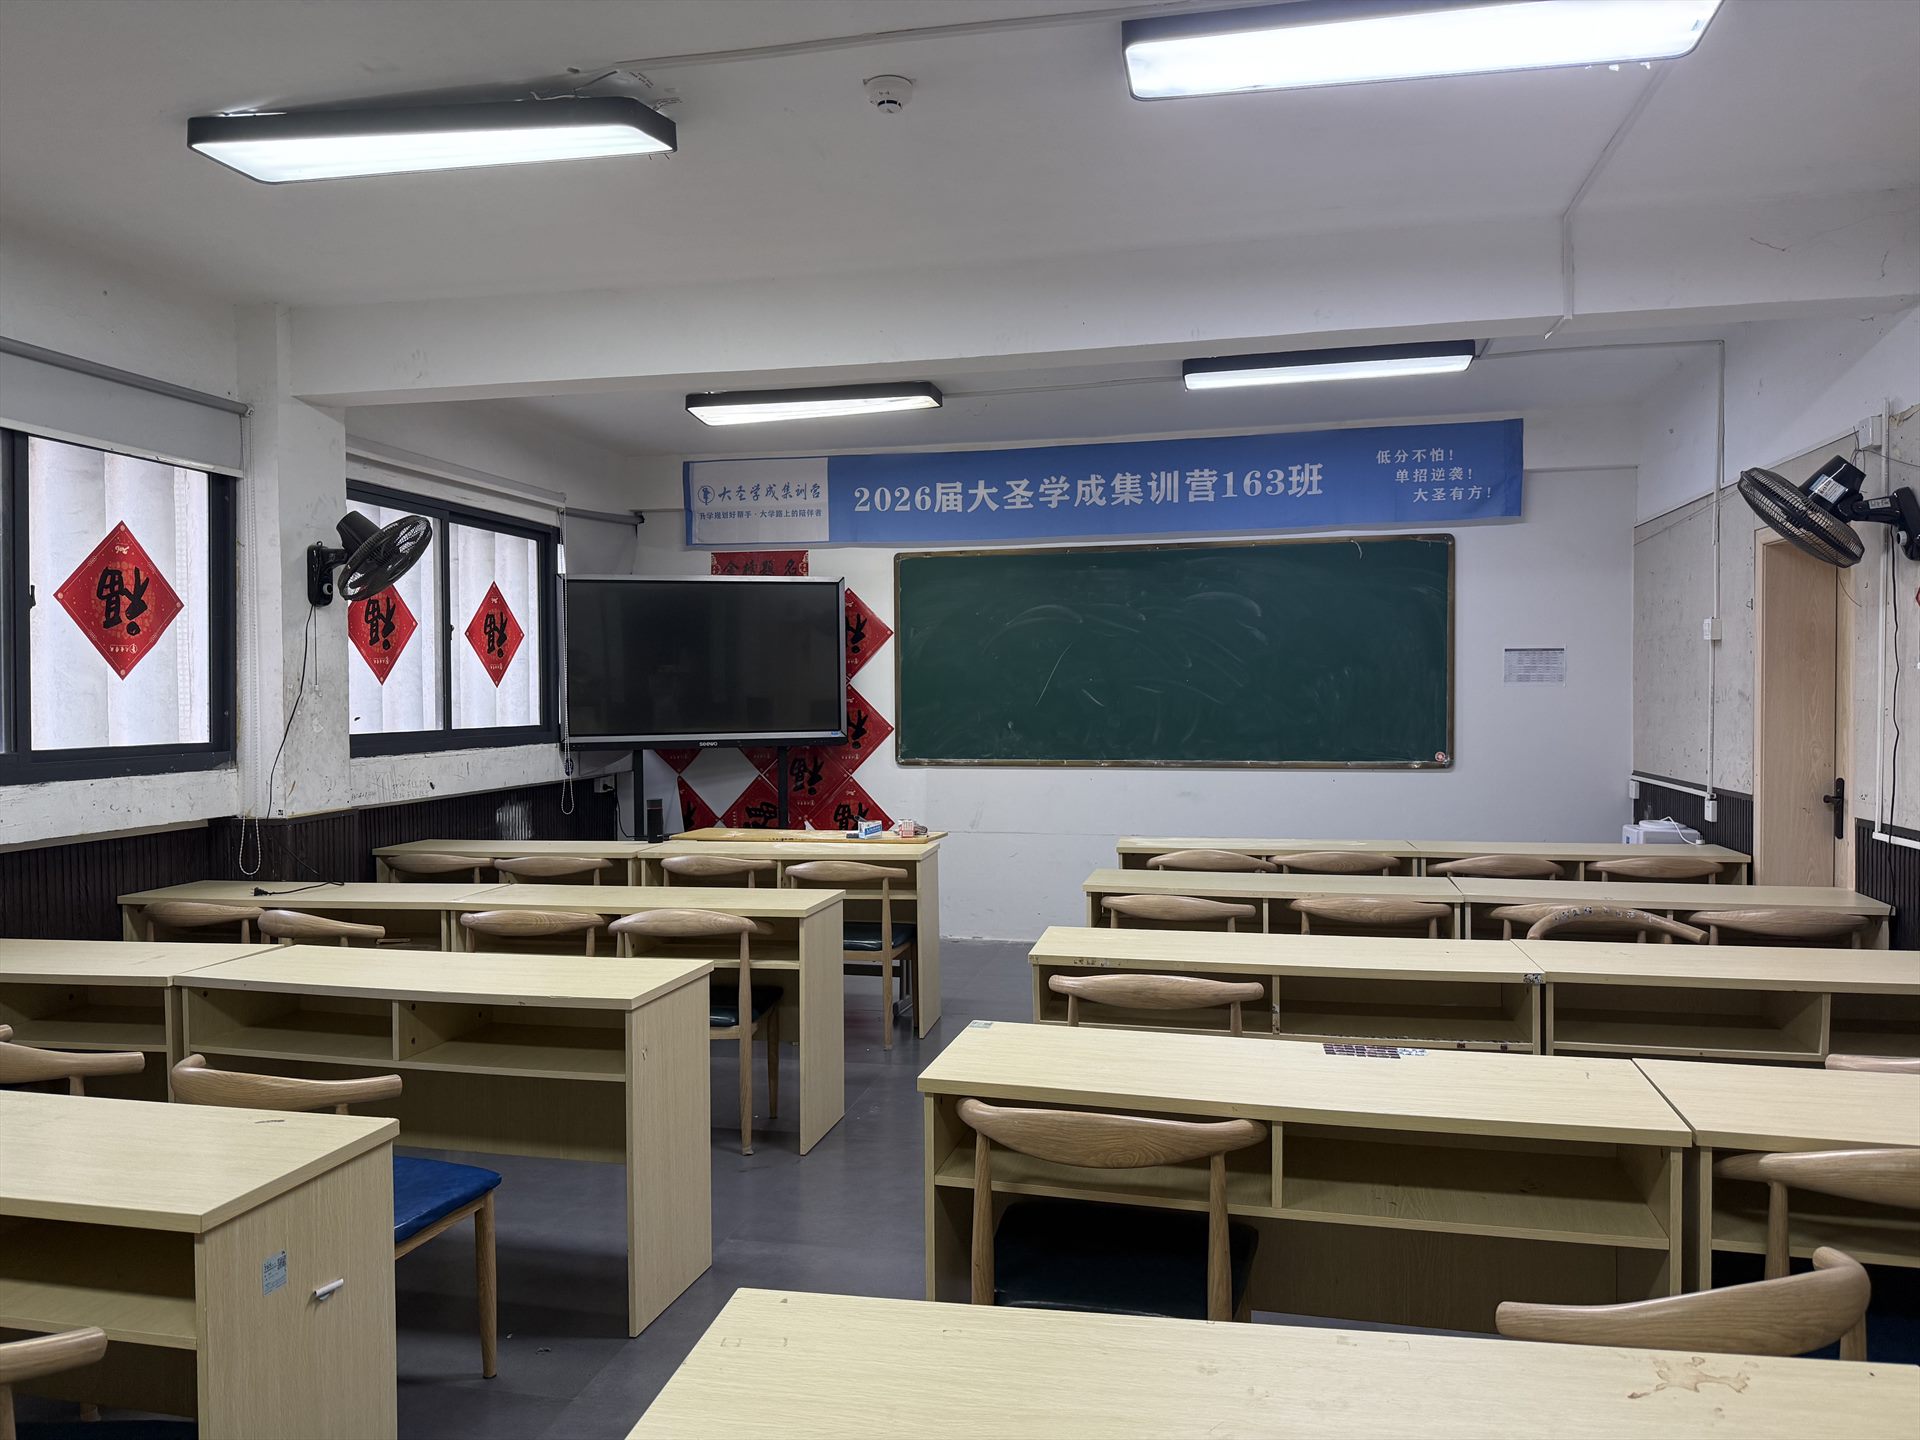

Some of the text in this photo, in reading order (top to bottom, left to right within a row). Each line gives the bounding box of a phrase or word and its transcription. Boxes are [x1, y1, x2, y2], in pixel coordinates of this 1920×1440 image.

[1376, 448, 1454, 465] 低分不怕！
[854, 462, 1324, 514] 2026届大圣学成集训营163班
[1395, 466, 1473, 484] 单招逆袭！
[717, 482, 821, 502] 大圣学成集训营
[1412, 486, 1493, 504] 大圣有方！
[96, 566, 149, 636] 福
[364, 596, 396, 650] 福
[483, 612, 508, 658] 福
